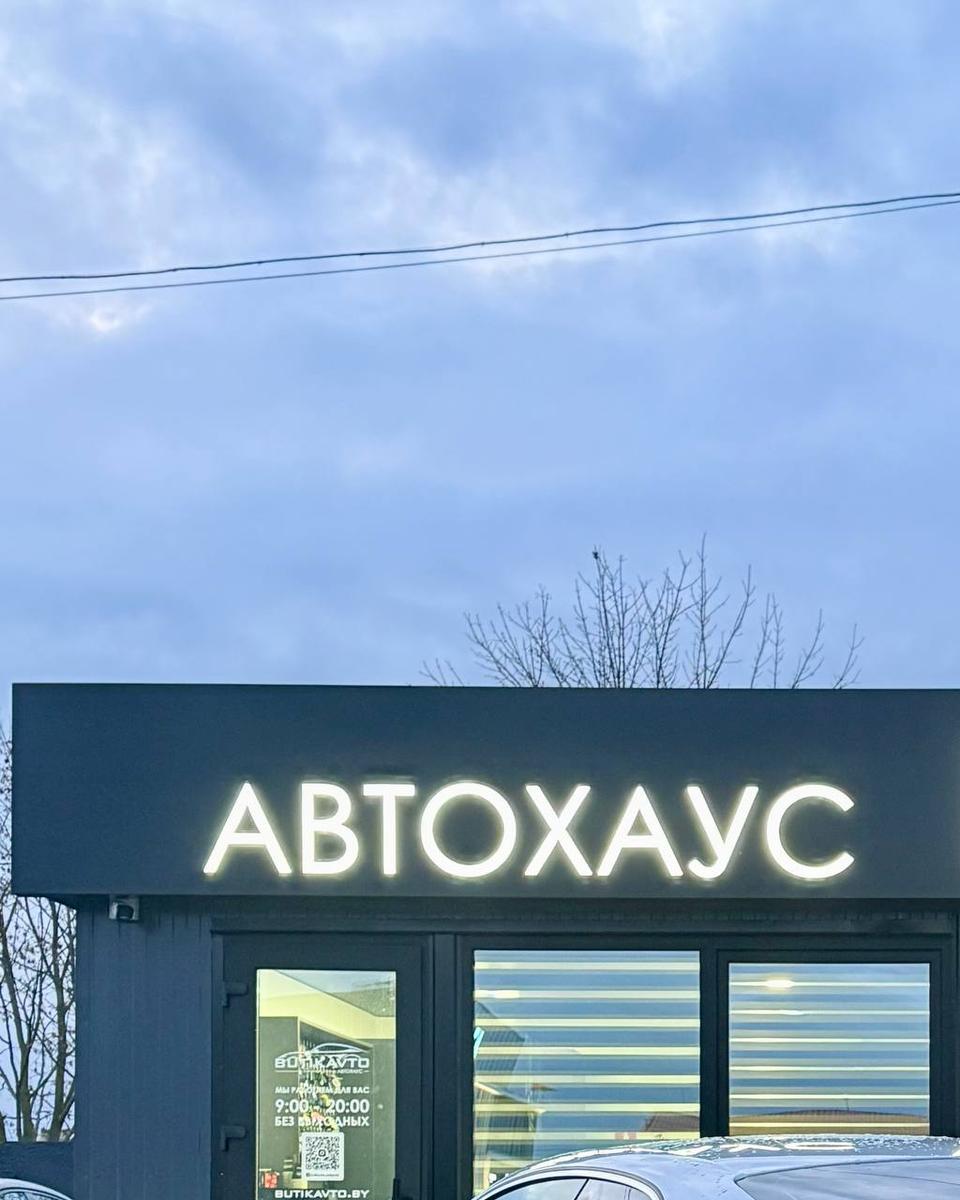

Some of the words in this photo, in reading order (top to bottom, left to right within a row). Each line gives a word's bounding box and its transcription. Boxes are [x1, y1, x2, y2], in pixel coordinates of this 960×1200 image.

[202, 781, 855, 879] АВТОХАУС
[274, 1057, 370, 1068] BUTIKAVTO
[274, 1086, 289, 1094] МЫ
[335, 1086, 351, 1095] ДЛЯ
[352, 1086, 370, 1094] ВАС
[275, 1099, 309, 1113] 9:00
[327, 1099, 370, 1113] 20:00
[275, 1116, 295, 1127] БЕЗ
[298, 1116, 370, 1127] ВЫХОДНЫХ
[274, 1189, 370, 1199] BUTIKAVTO.BY
